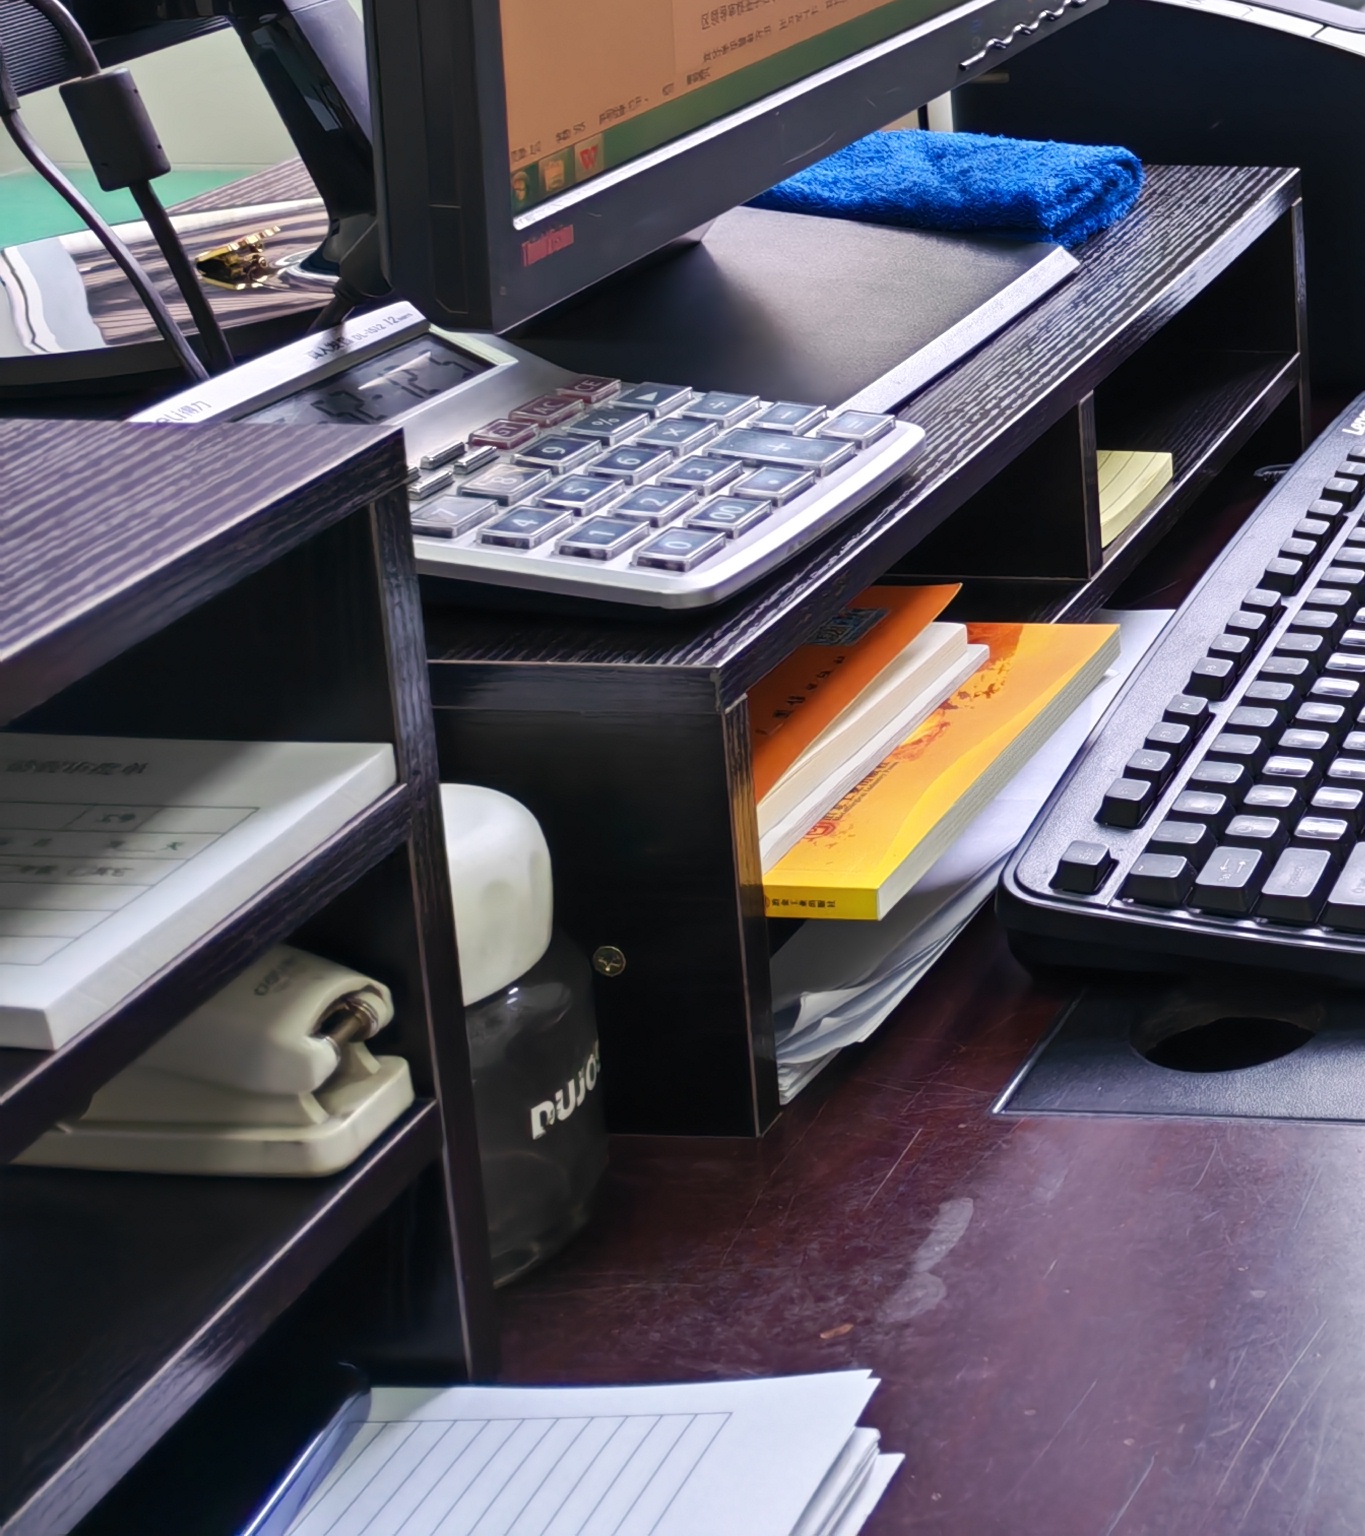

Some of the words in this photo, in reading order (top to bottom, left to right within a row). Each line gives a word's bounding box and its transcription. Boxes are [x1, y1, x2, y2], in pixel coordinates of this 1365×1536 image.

[580, 376, 604, 393] CE
[535, 398, 557, 415] AC
[568, 485, 586, 497] 5
[651, 496, 668, 508] 2
[708, 504, 736, 521] 00
[521, 516, 537, 529] 4
